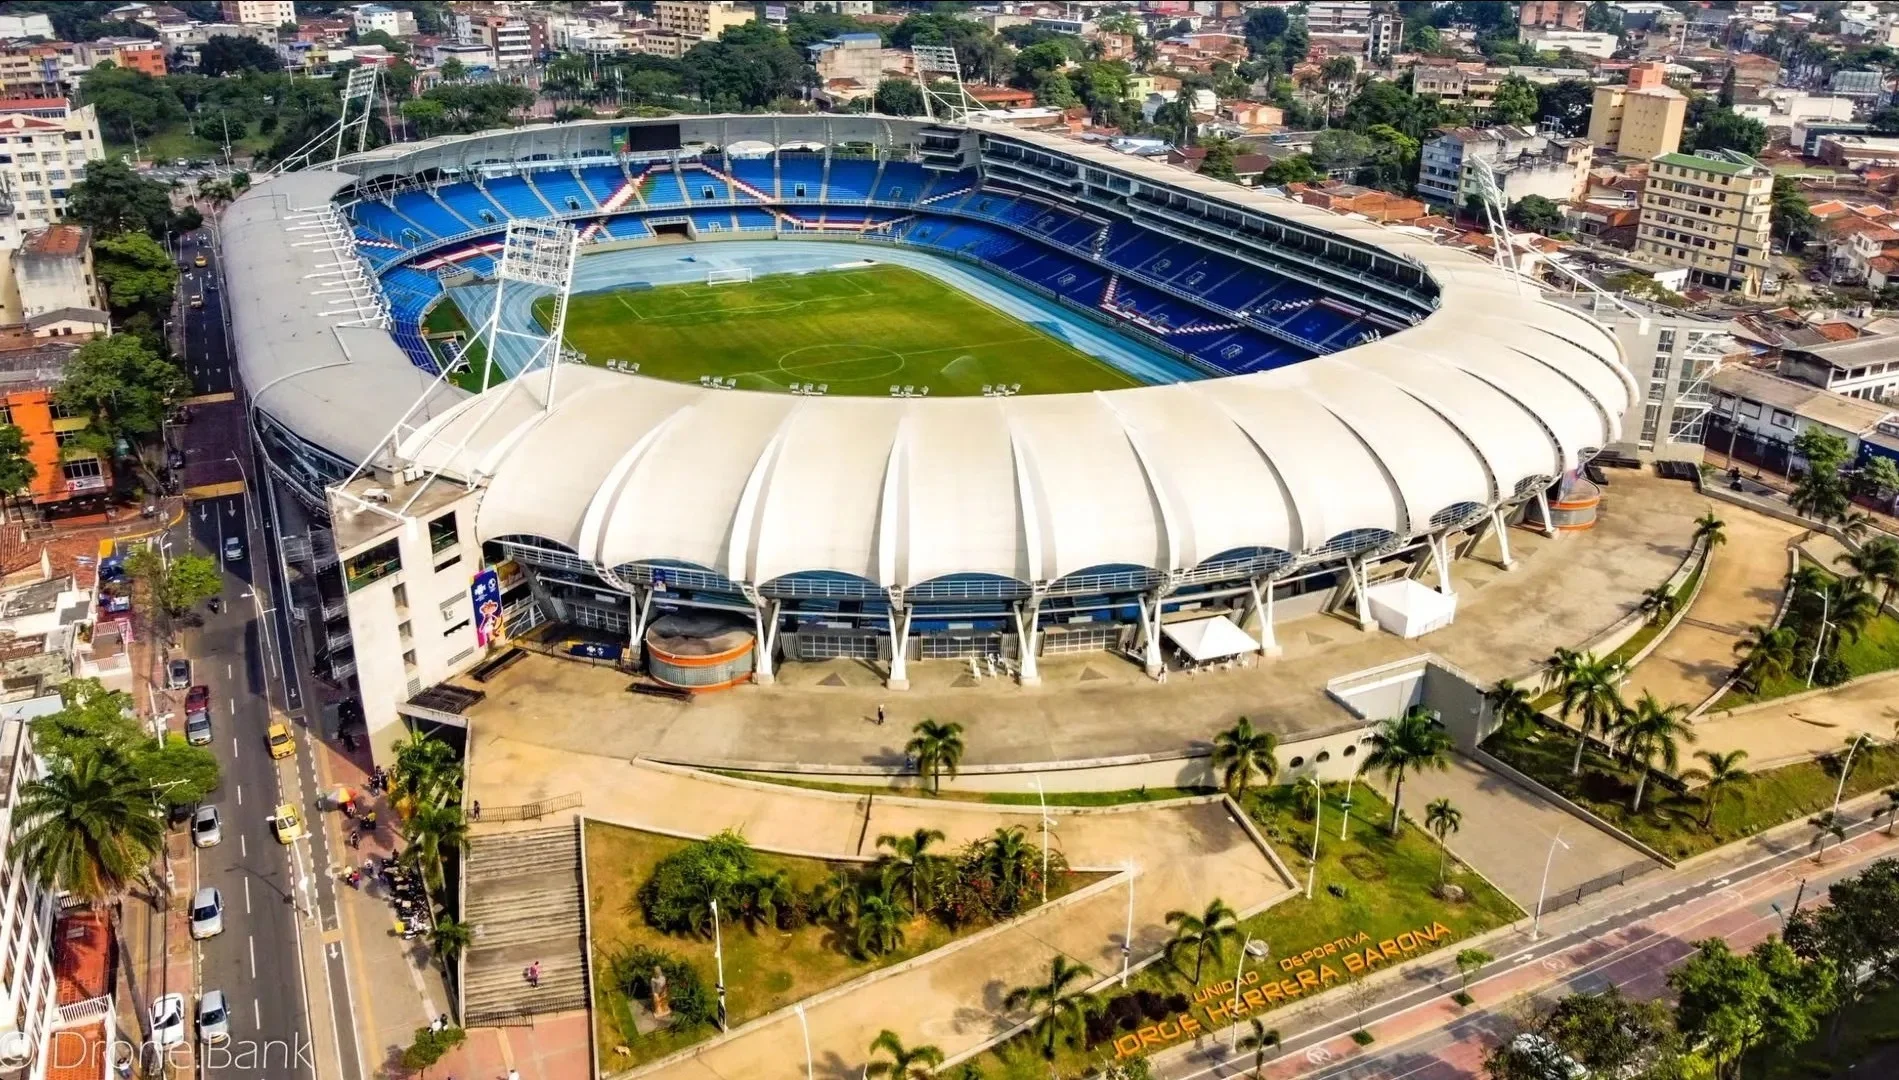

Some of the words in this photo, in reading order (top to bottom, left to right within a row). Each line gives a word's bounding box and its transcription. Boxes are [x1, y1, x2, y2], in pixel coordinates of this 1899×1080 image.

[1193, 970, 1260, 1003] UNIDAD
[1279, 931, 1371, 971] DEPORTIVA
[1205, 964, 1339, 1023] HERRERA
[1342, 921, 1452, 972] BARONA
